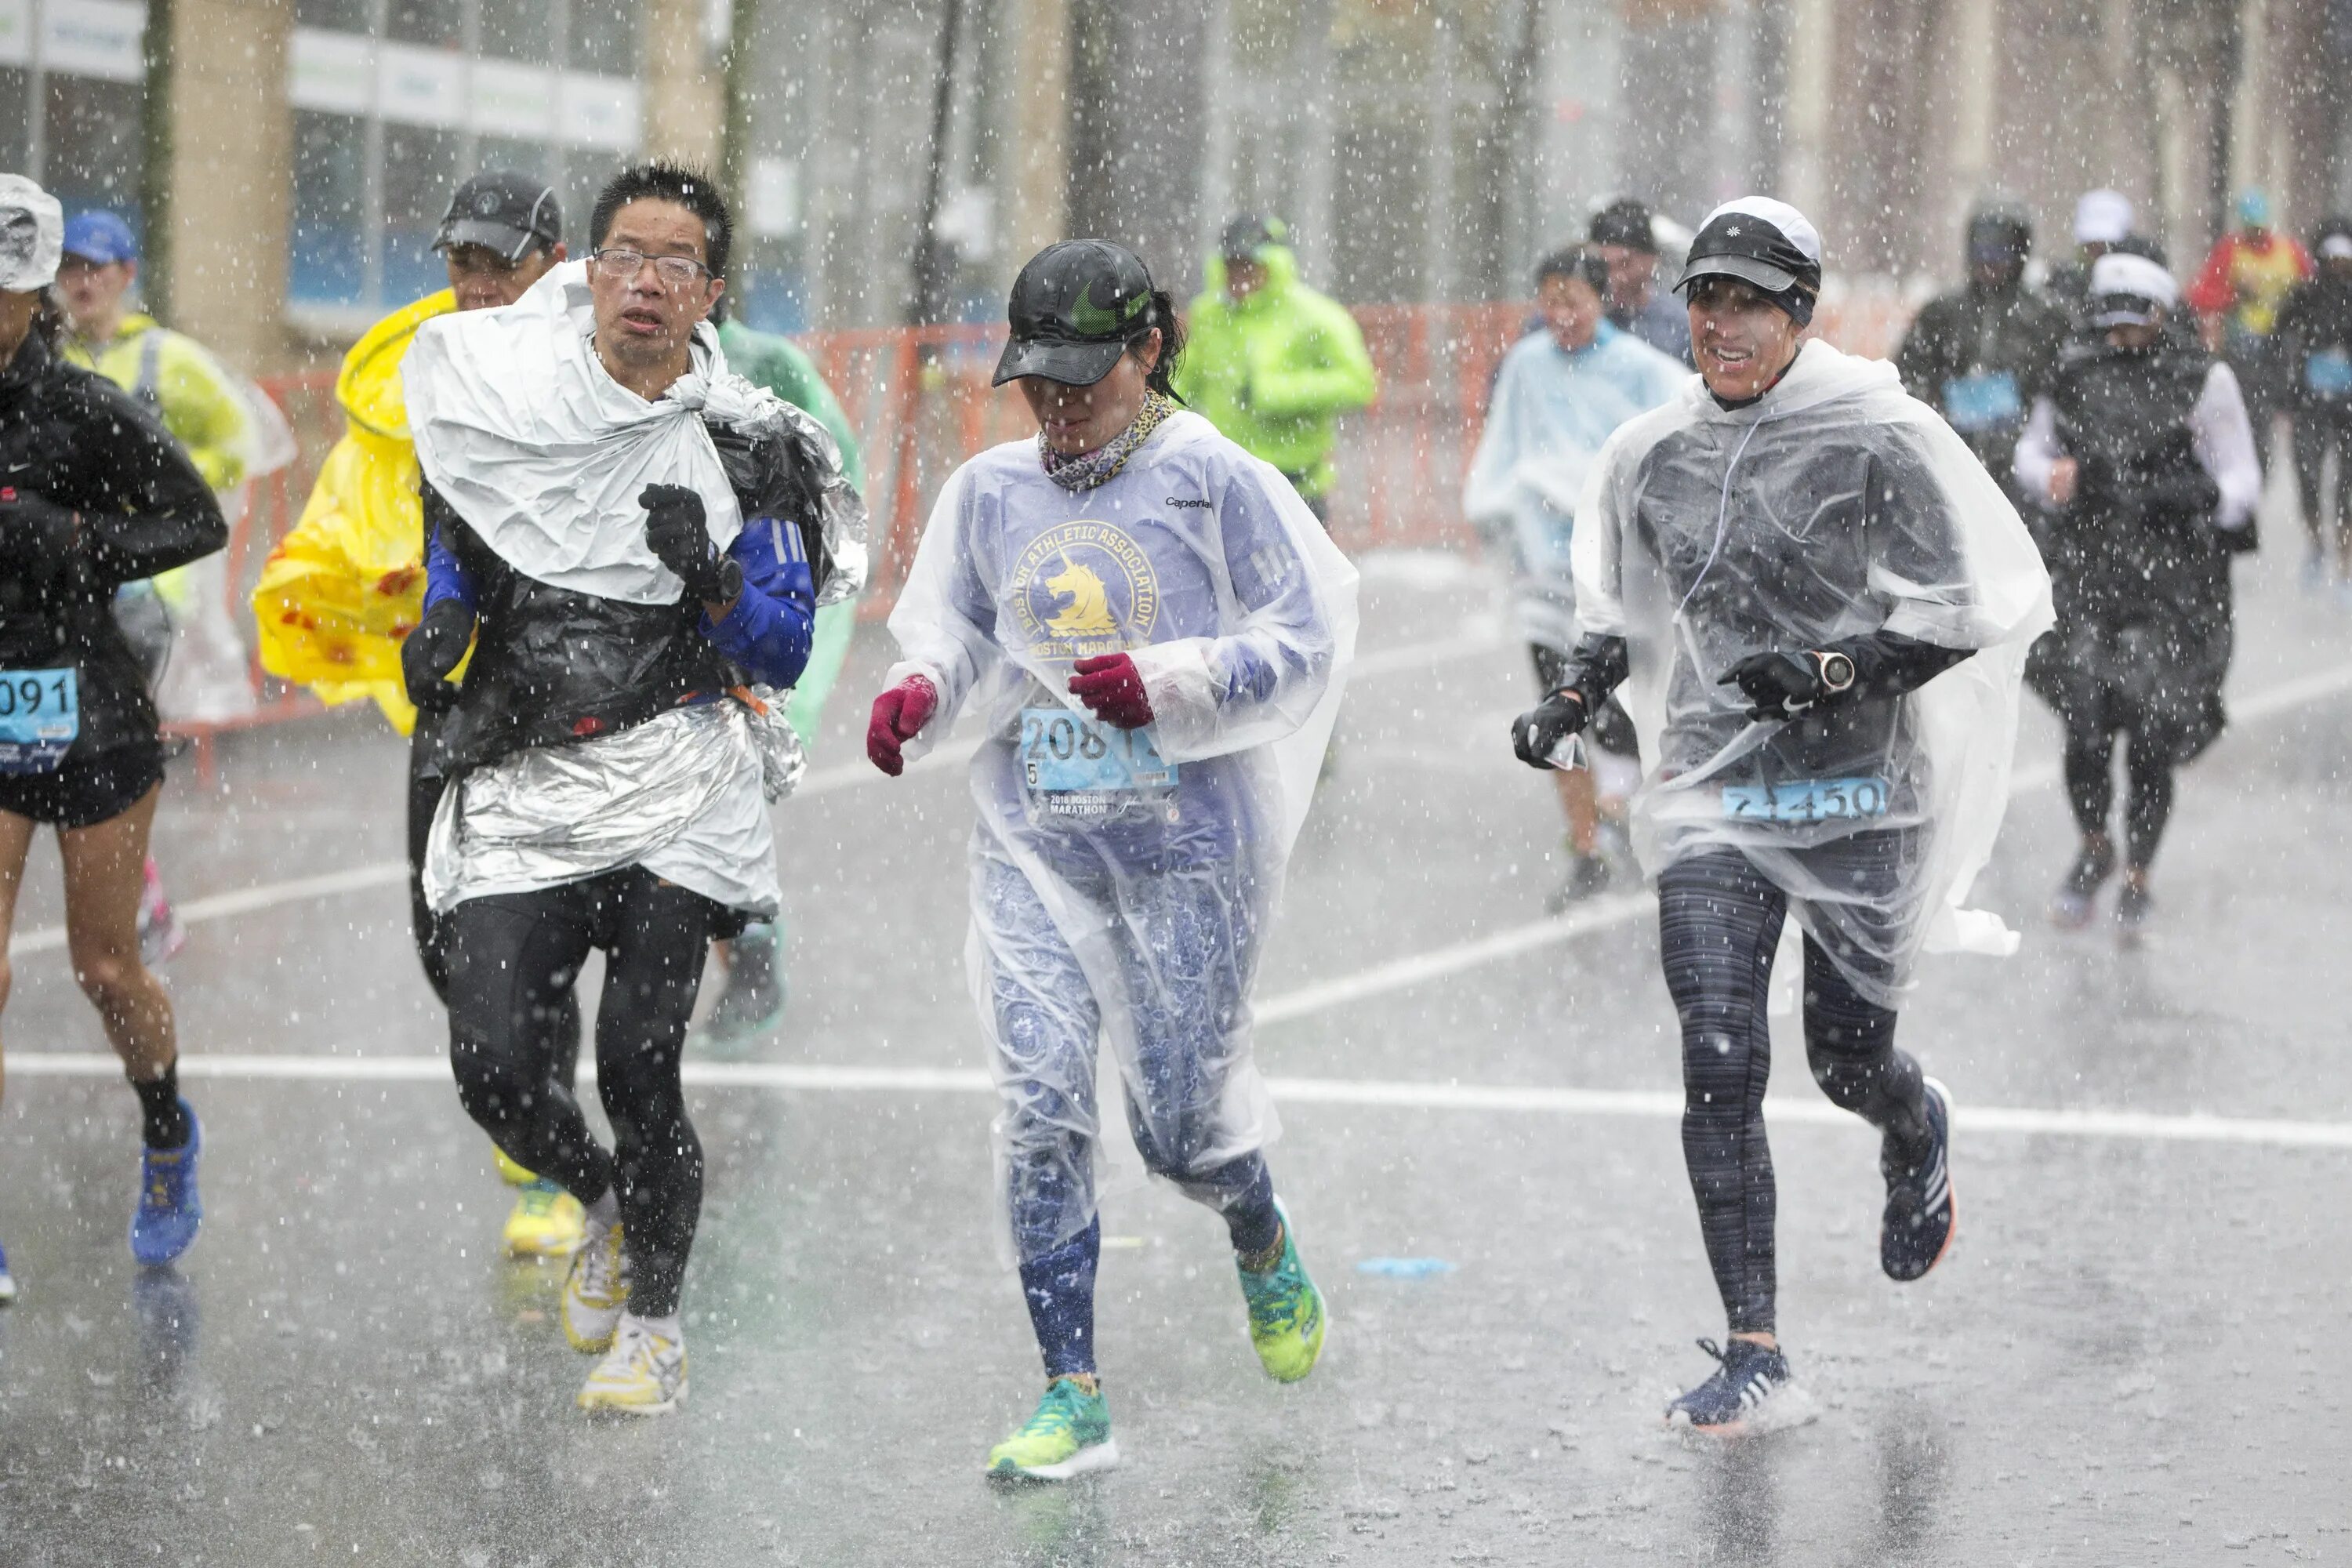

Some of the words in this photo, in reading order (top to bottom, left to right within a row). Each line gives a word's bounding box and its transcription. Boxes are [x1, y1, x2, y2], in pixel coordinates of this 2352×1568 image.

[1027, 525, 1097, 565] ATHLETIC
[1098, 528, 1154, 626] ASSOCIATION
[1028, 717, 1160, 760] 2081
[1028, 764, 1037, 784] 5
[1051, 795, 1069, 804] 2018
[1071, 795, 1105, 804] BOSTON
[1051, 804, 1107, 815] MARATHON
